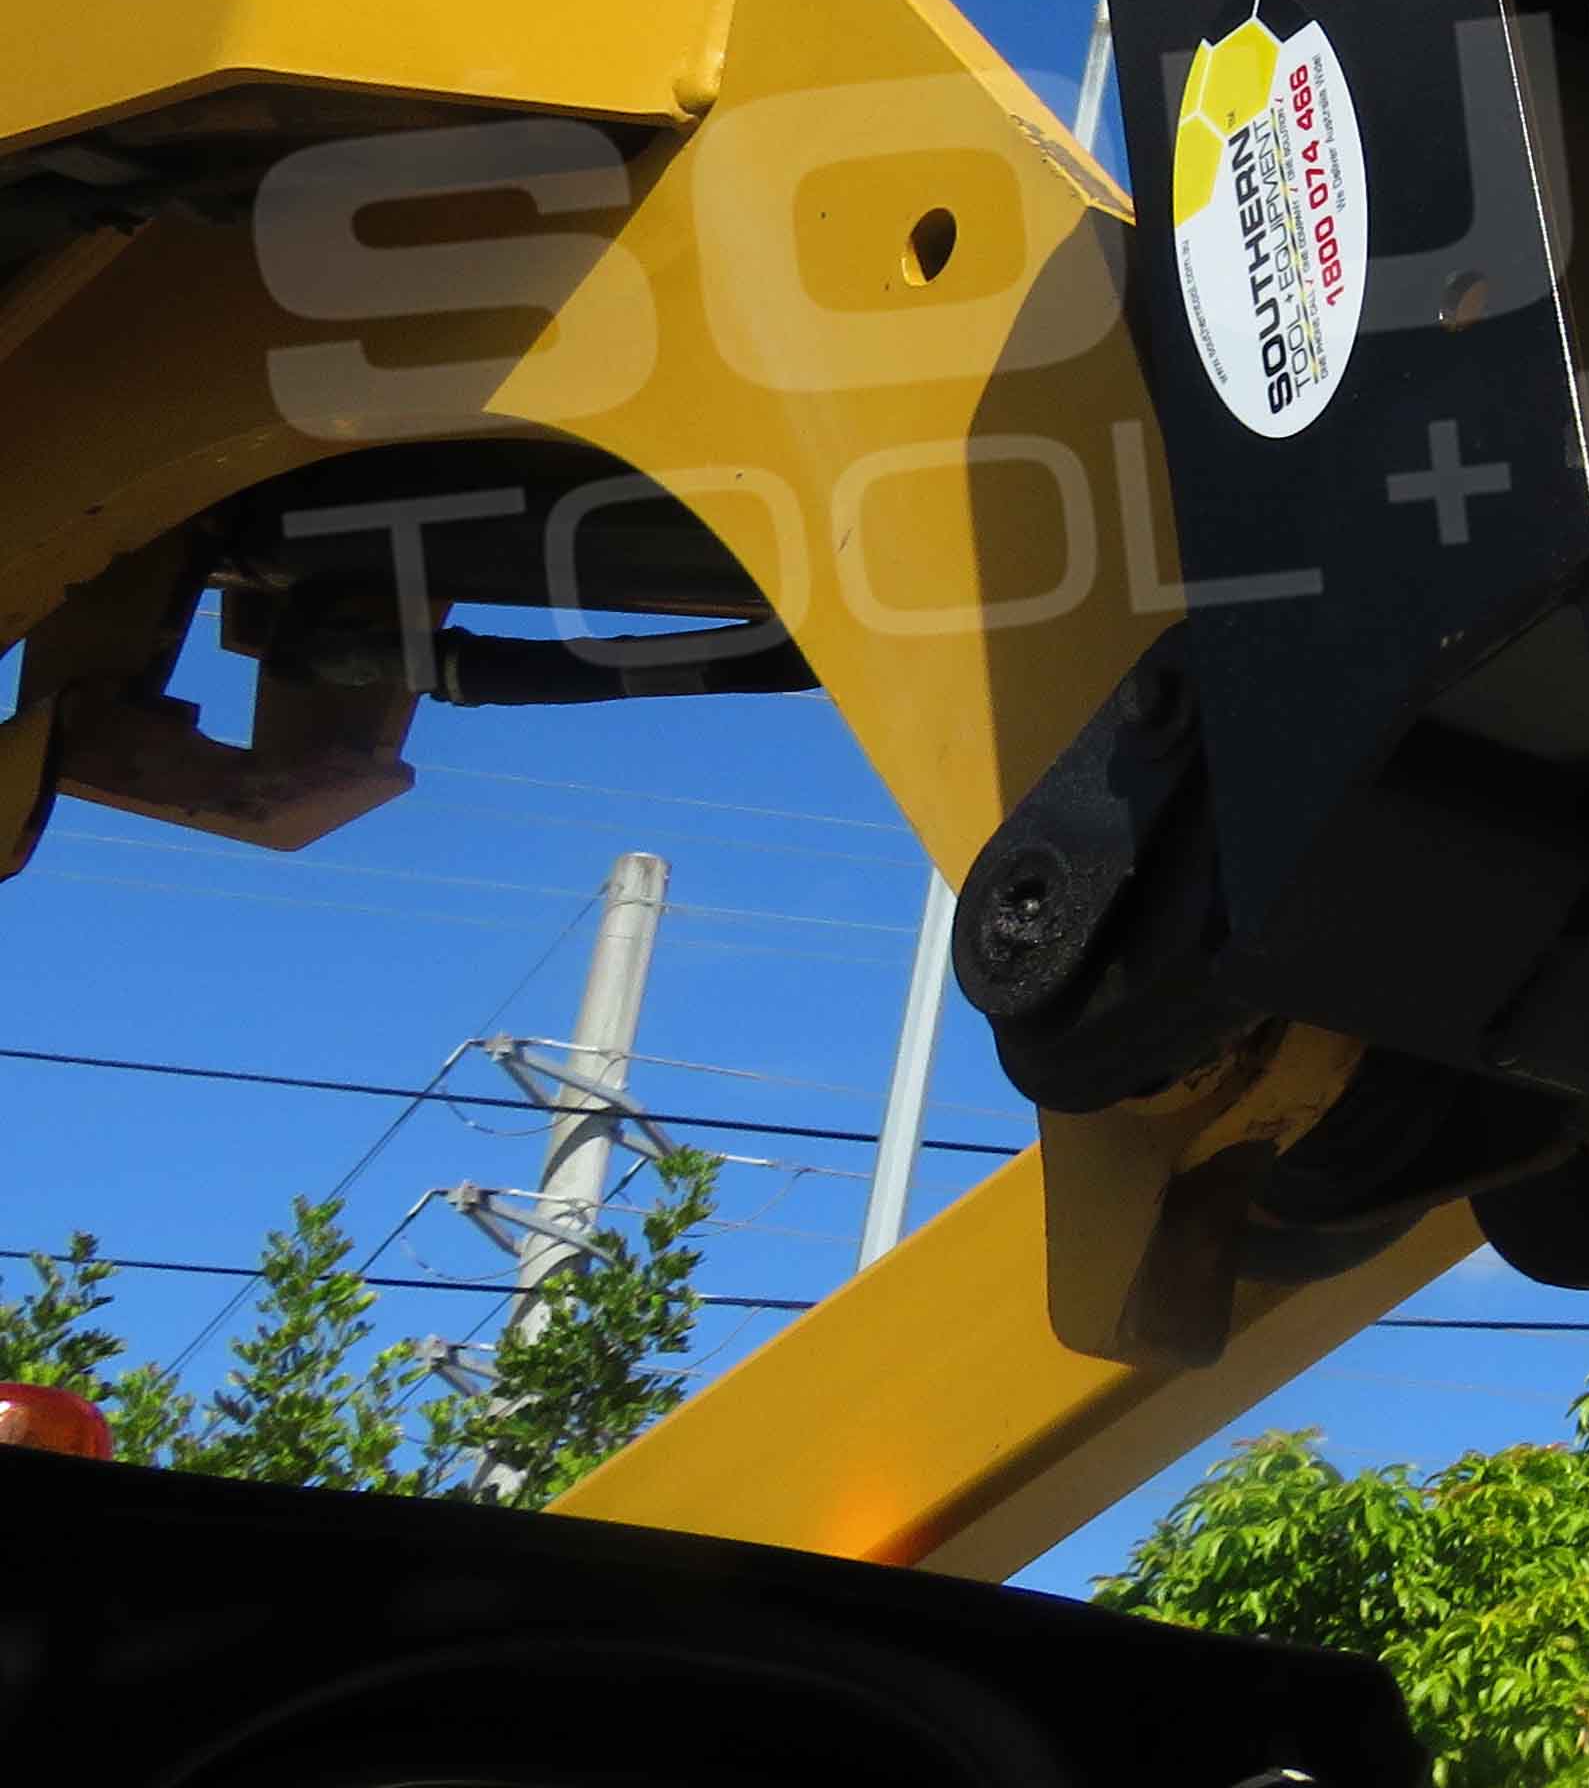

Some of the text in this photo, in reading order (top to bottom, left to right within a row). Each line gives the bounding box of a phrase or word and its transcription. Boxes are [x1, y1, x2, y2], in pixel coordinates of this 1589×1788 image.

[1228, 125, 1293, 414] SOUTHERN
[1253, 119, 1295, 291] EQUIPMENT
[1289, 65, 1344, 306] 1800 074 466
[1287, 304, 1311, 398] TOOL
